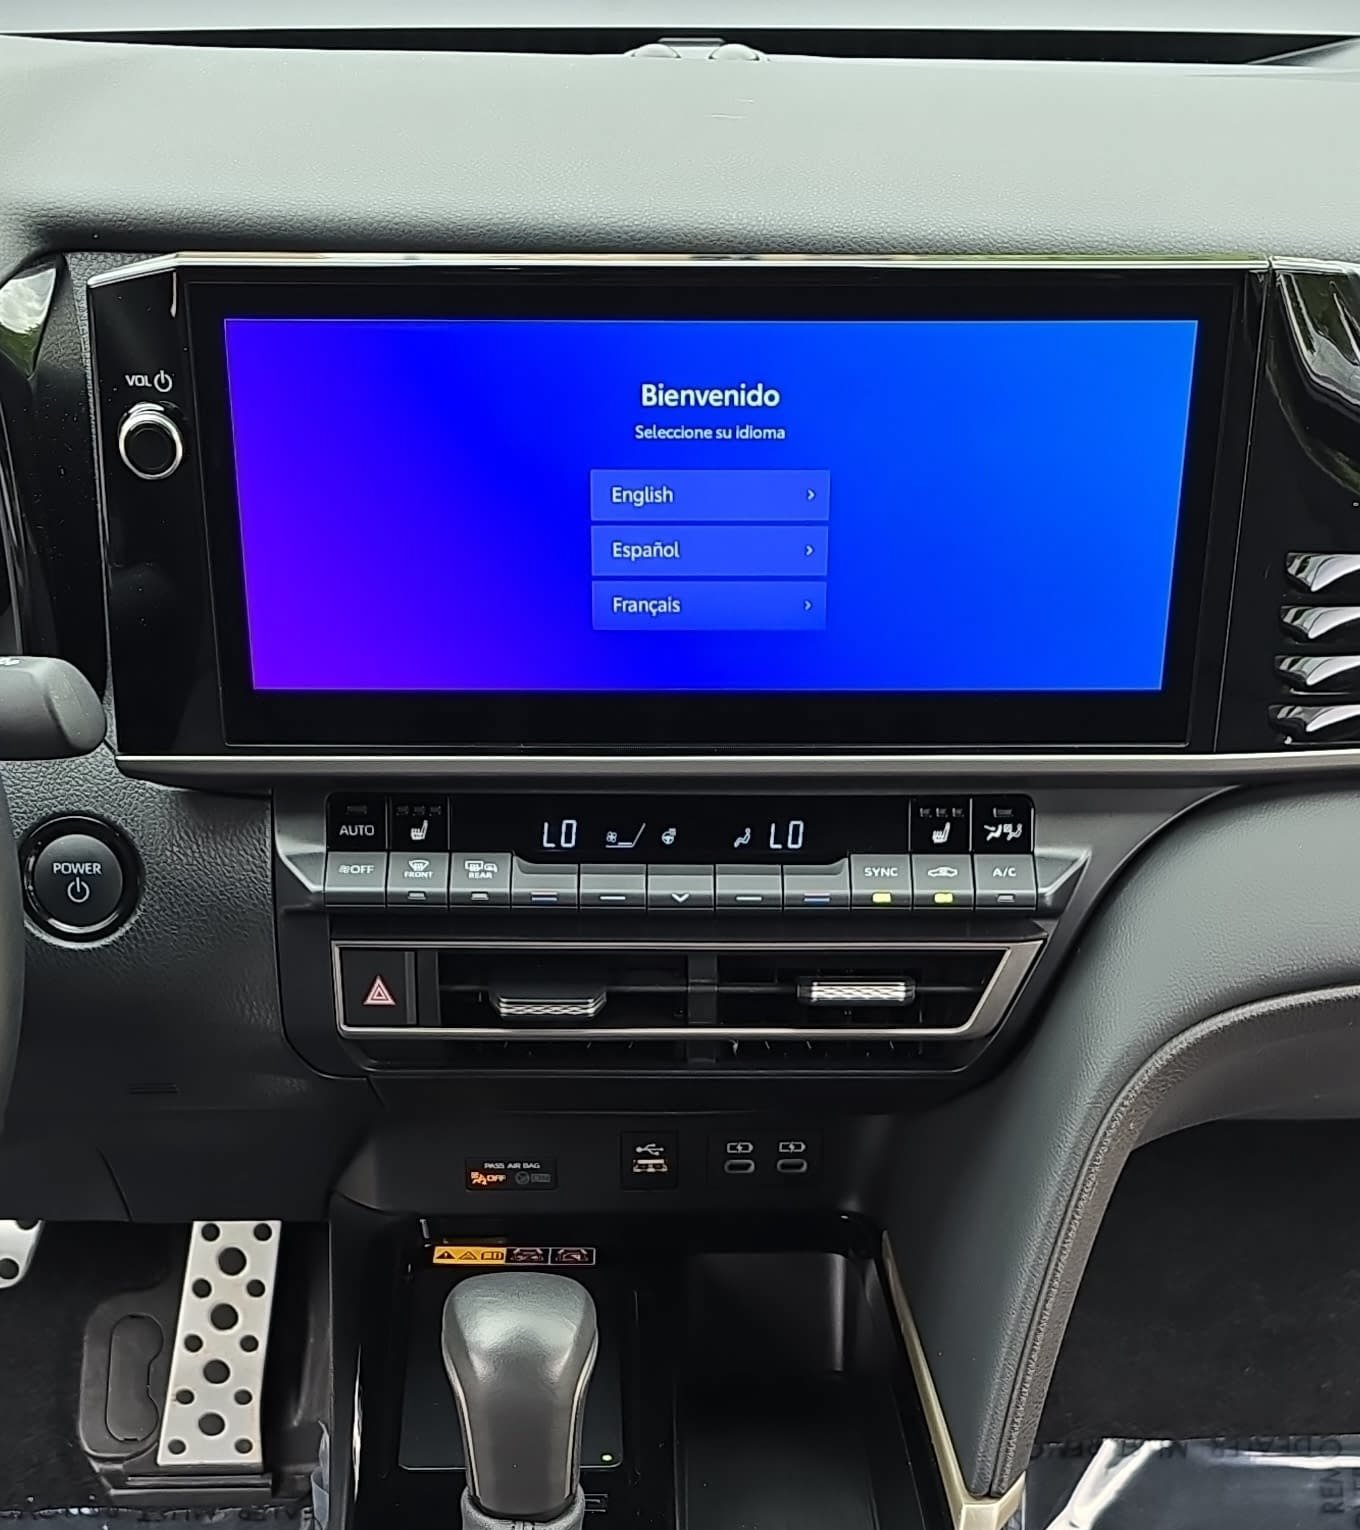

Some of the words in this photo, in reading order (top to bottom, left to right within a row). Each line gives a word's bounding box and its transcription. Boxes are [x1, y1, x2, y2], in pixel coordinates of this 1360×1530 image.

[125, 375, 153, 387] VOL
[641, 382, 780, 407] Bienvenido
[635, 425, 713, 440] Seleccione
[715, 427, 732, 440] su
[735, 425, 786, 440] idioma
[611, 485, 674, 506] English
[612, 541, 680, 561] Español
[613, 596, 681, 617] Français
[339, 824, 375, 836] AUTO
[543, 820, 577, 848] LO
[769, 820, 805, 848] LO
[53, 863, 101, 874] POWER
[350, 864, 375, 874] OFF
[864, 867, 898, 877] SYNC
[993, 867, 1017, 878] A/C
